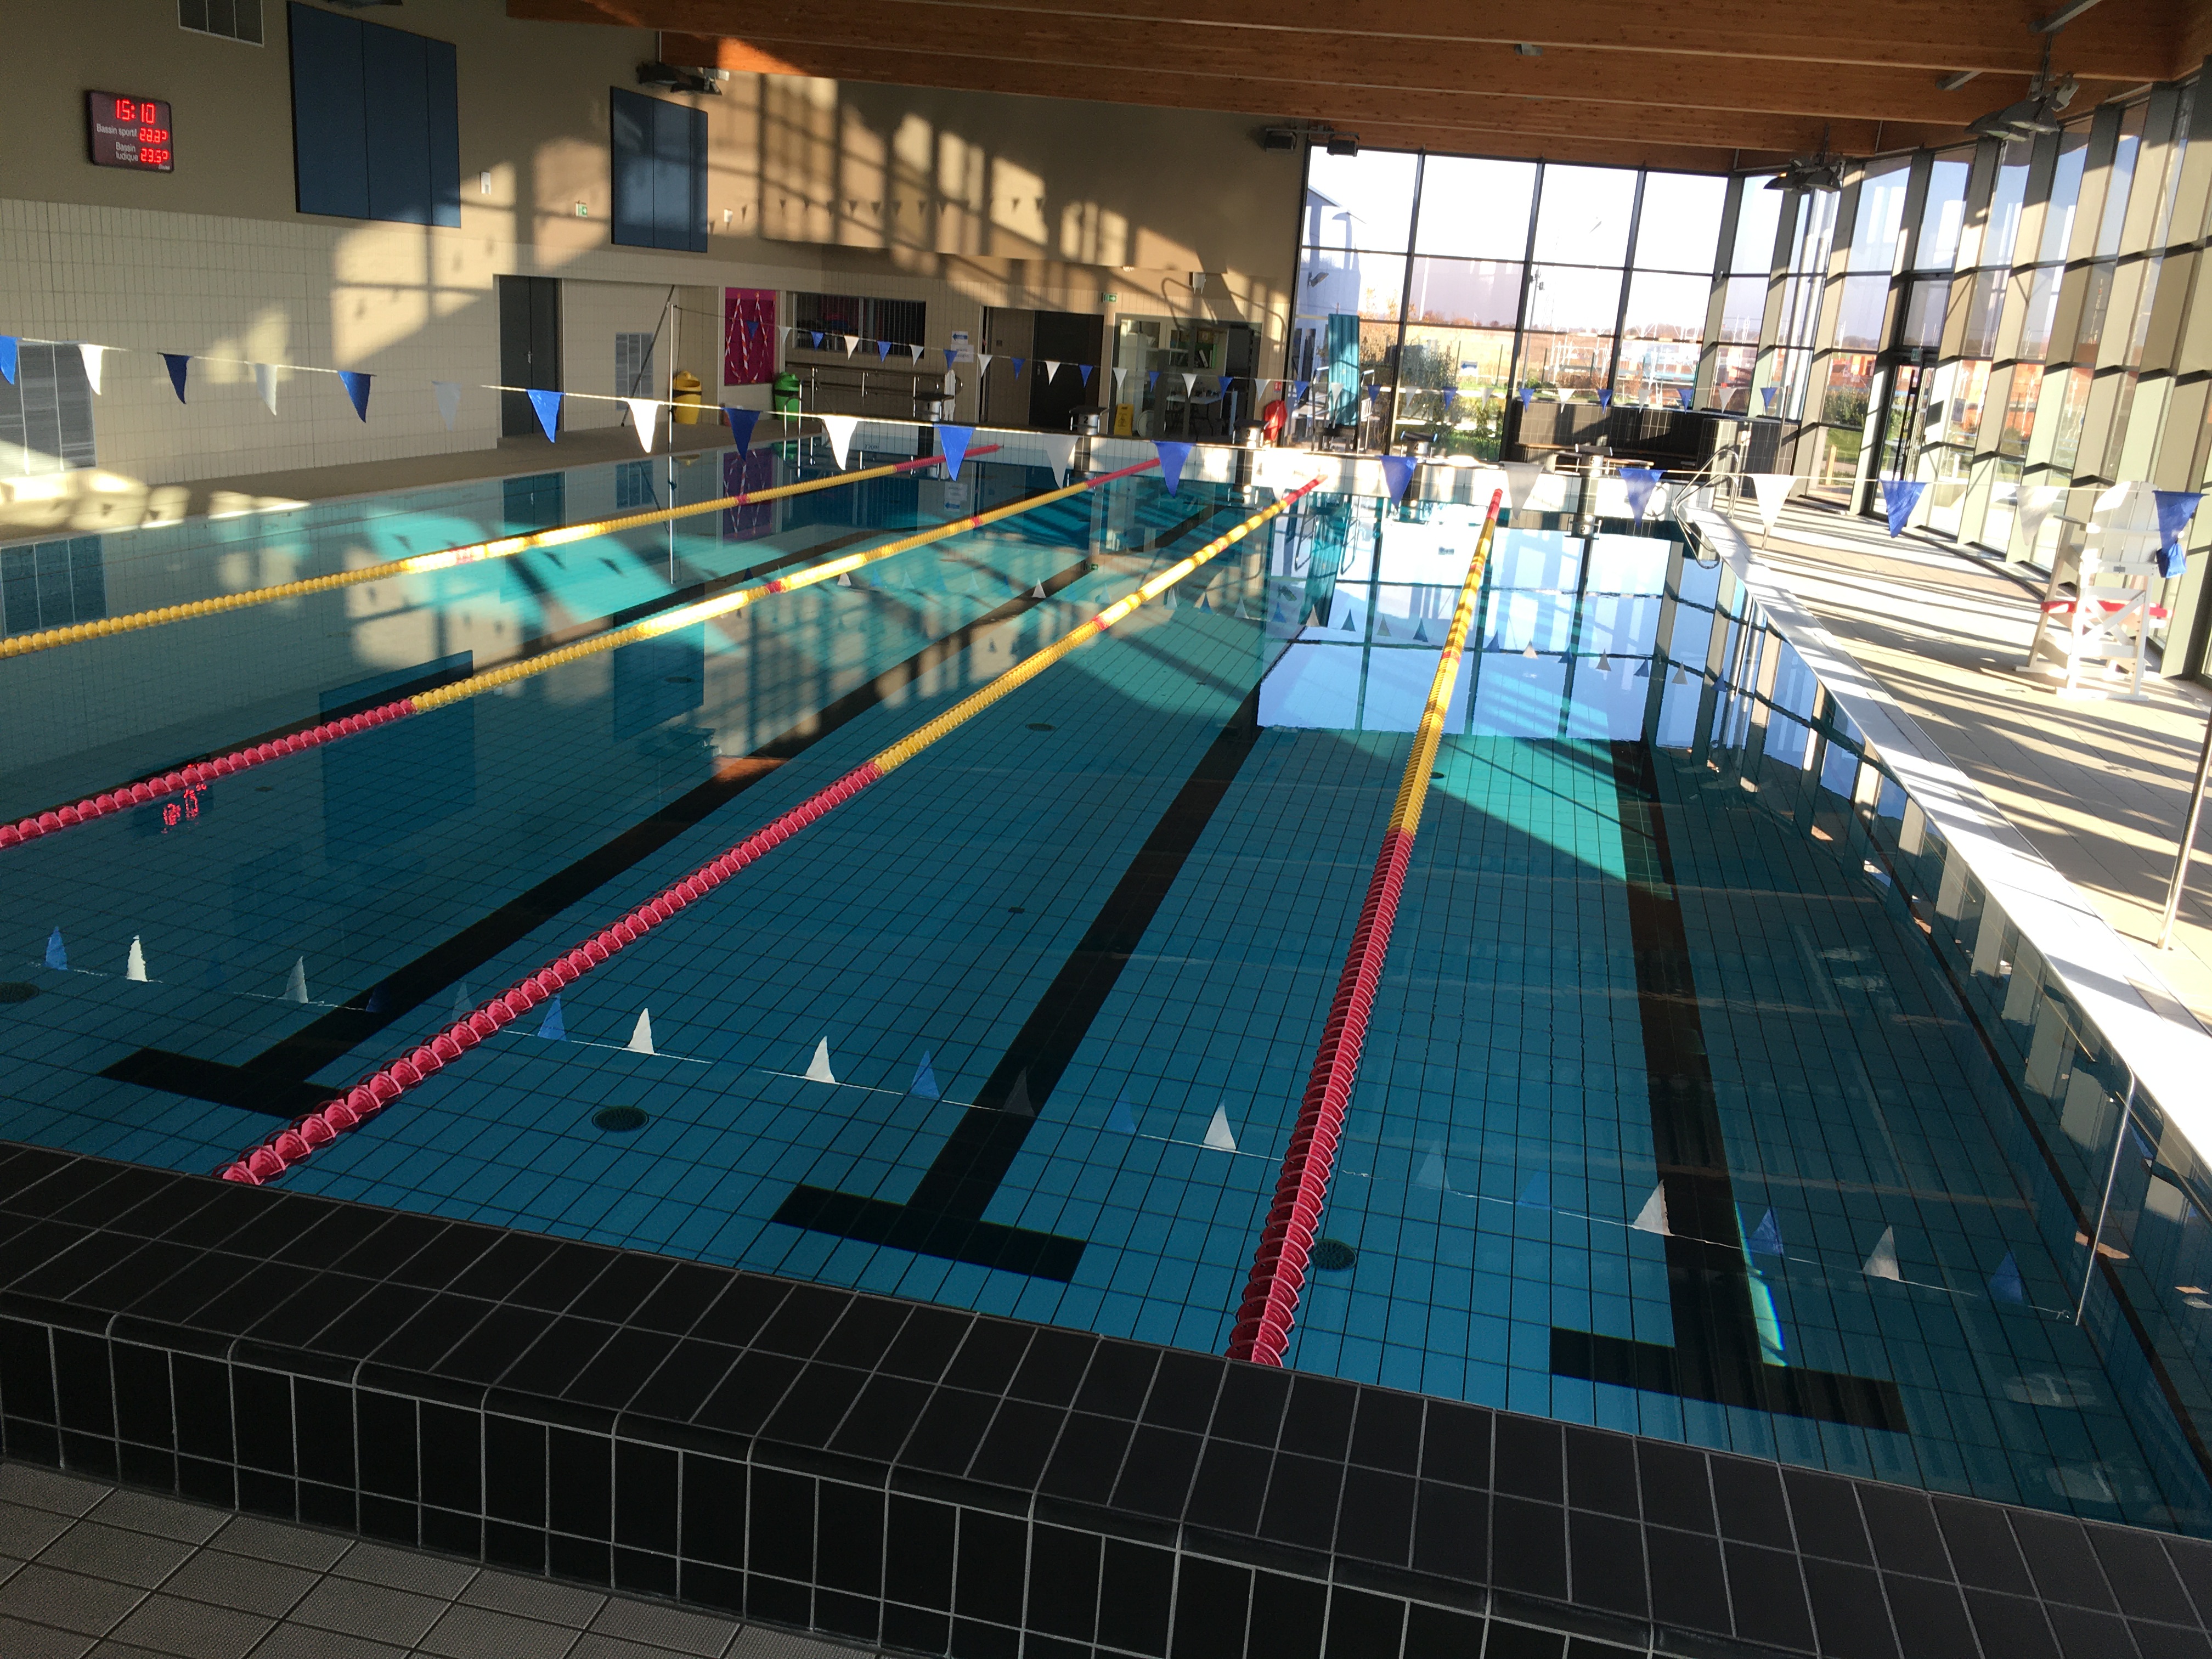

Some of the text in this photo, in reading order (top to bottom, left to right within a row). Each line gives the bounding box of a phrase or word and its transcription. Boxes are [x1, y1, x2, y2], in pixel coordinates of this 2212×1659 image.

[116, 99, 155, 124] 15:10
[96, 123, 117, 134] Bassin
[119, 127, 137, 138] sportif
[116, 142, 136, 152] Bassin
[116, 151, 138, 162] ludique
